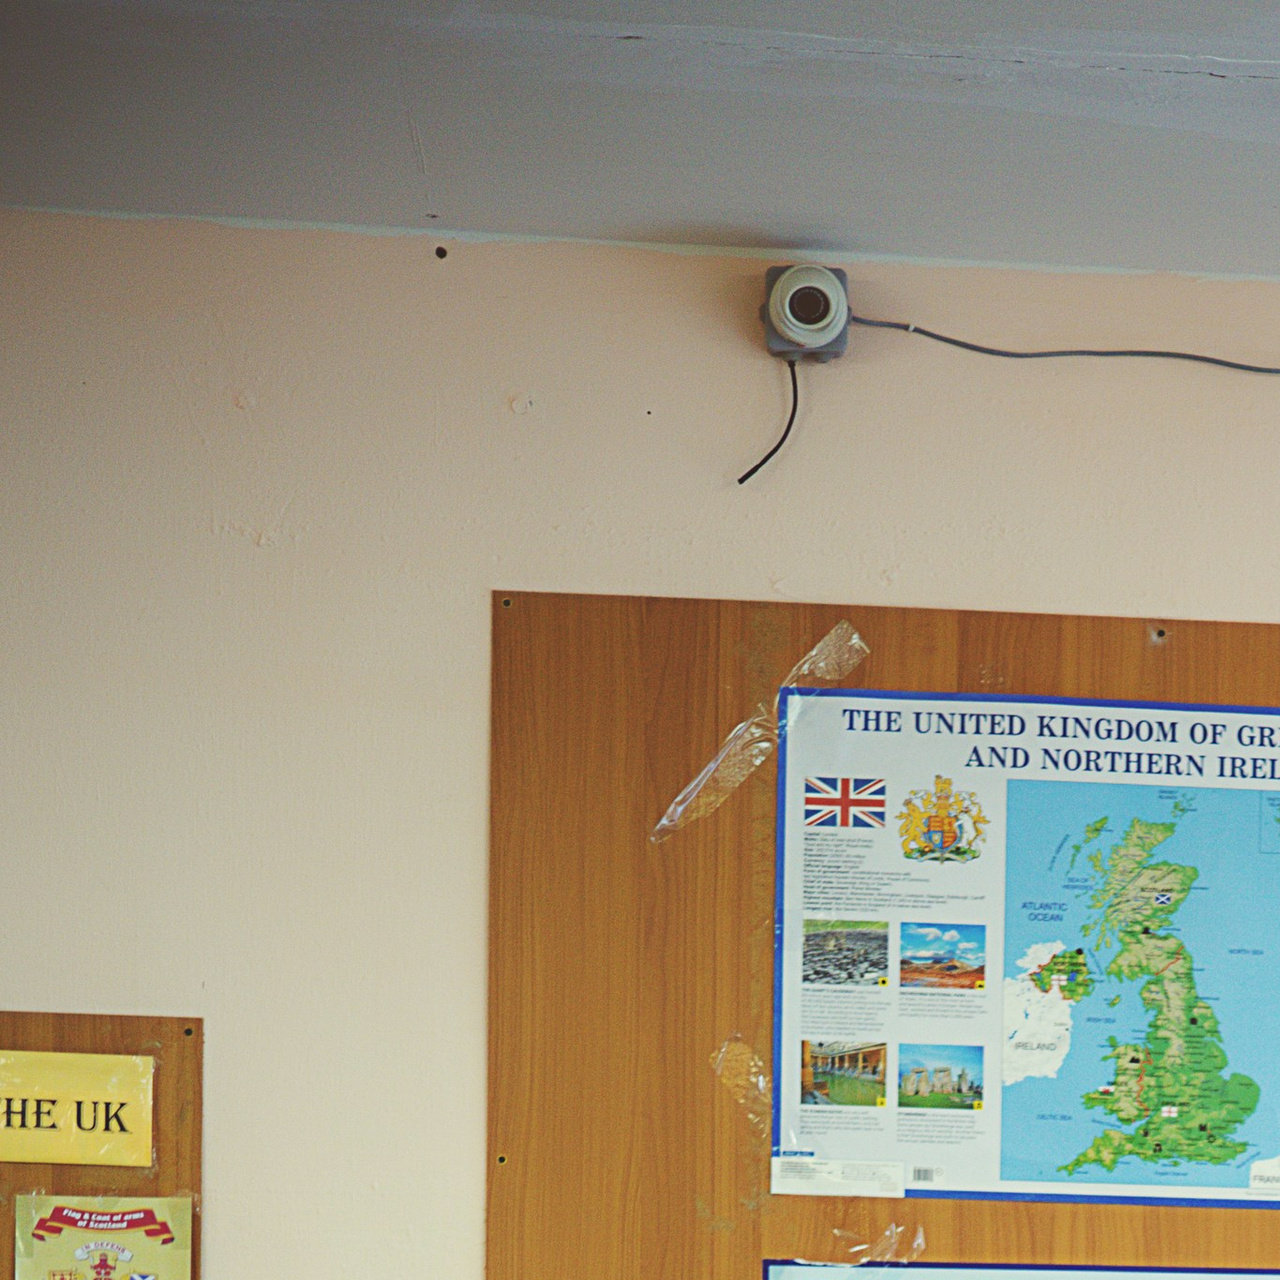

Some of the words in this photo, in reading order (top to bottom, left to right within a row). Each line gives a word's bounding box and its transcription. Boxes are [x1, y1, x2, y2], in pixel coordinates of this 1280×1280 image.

[842, 708, 902, 733] THE
[912, 711, 1027, 737] UNITED
[1036, 714, 1178, 744] KINGDOM
[1189, 721, 1227, 746] OF
[964, 745, 1030, 770] AND
[1039, 748, 1206, 777] NORTHERN
[1021, 901, 1068, 912] ATLANTIC
[1028, 912, 1064, 922] OCEAN
[1014, 1041, 1057, 1052] IRELAND
[0, 1096, 59, 1130] HE
[75, 1100, 131, 1133] UK
[62, 1208, 82, 1220] Flag
[89, 1221, 128, 1230] Scotland
